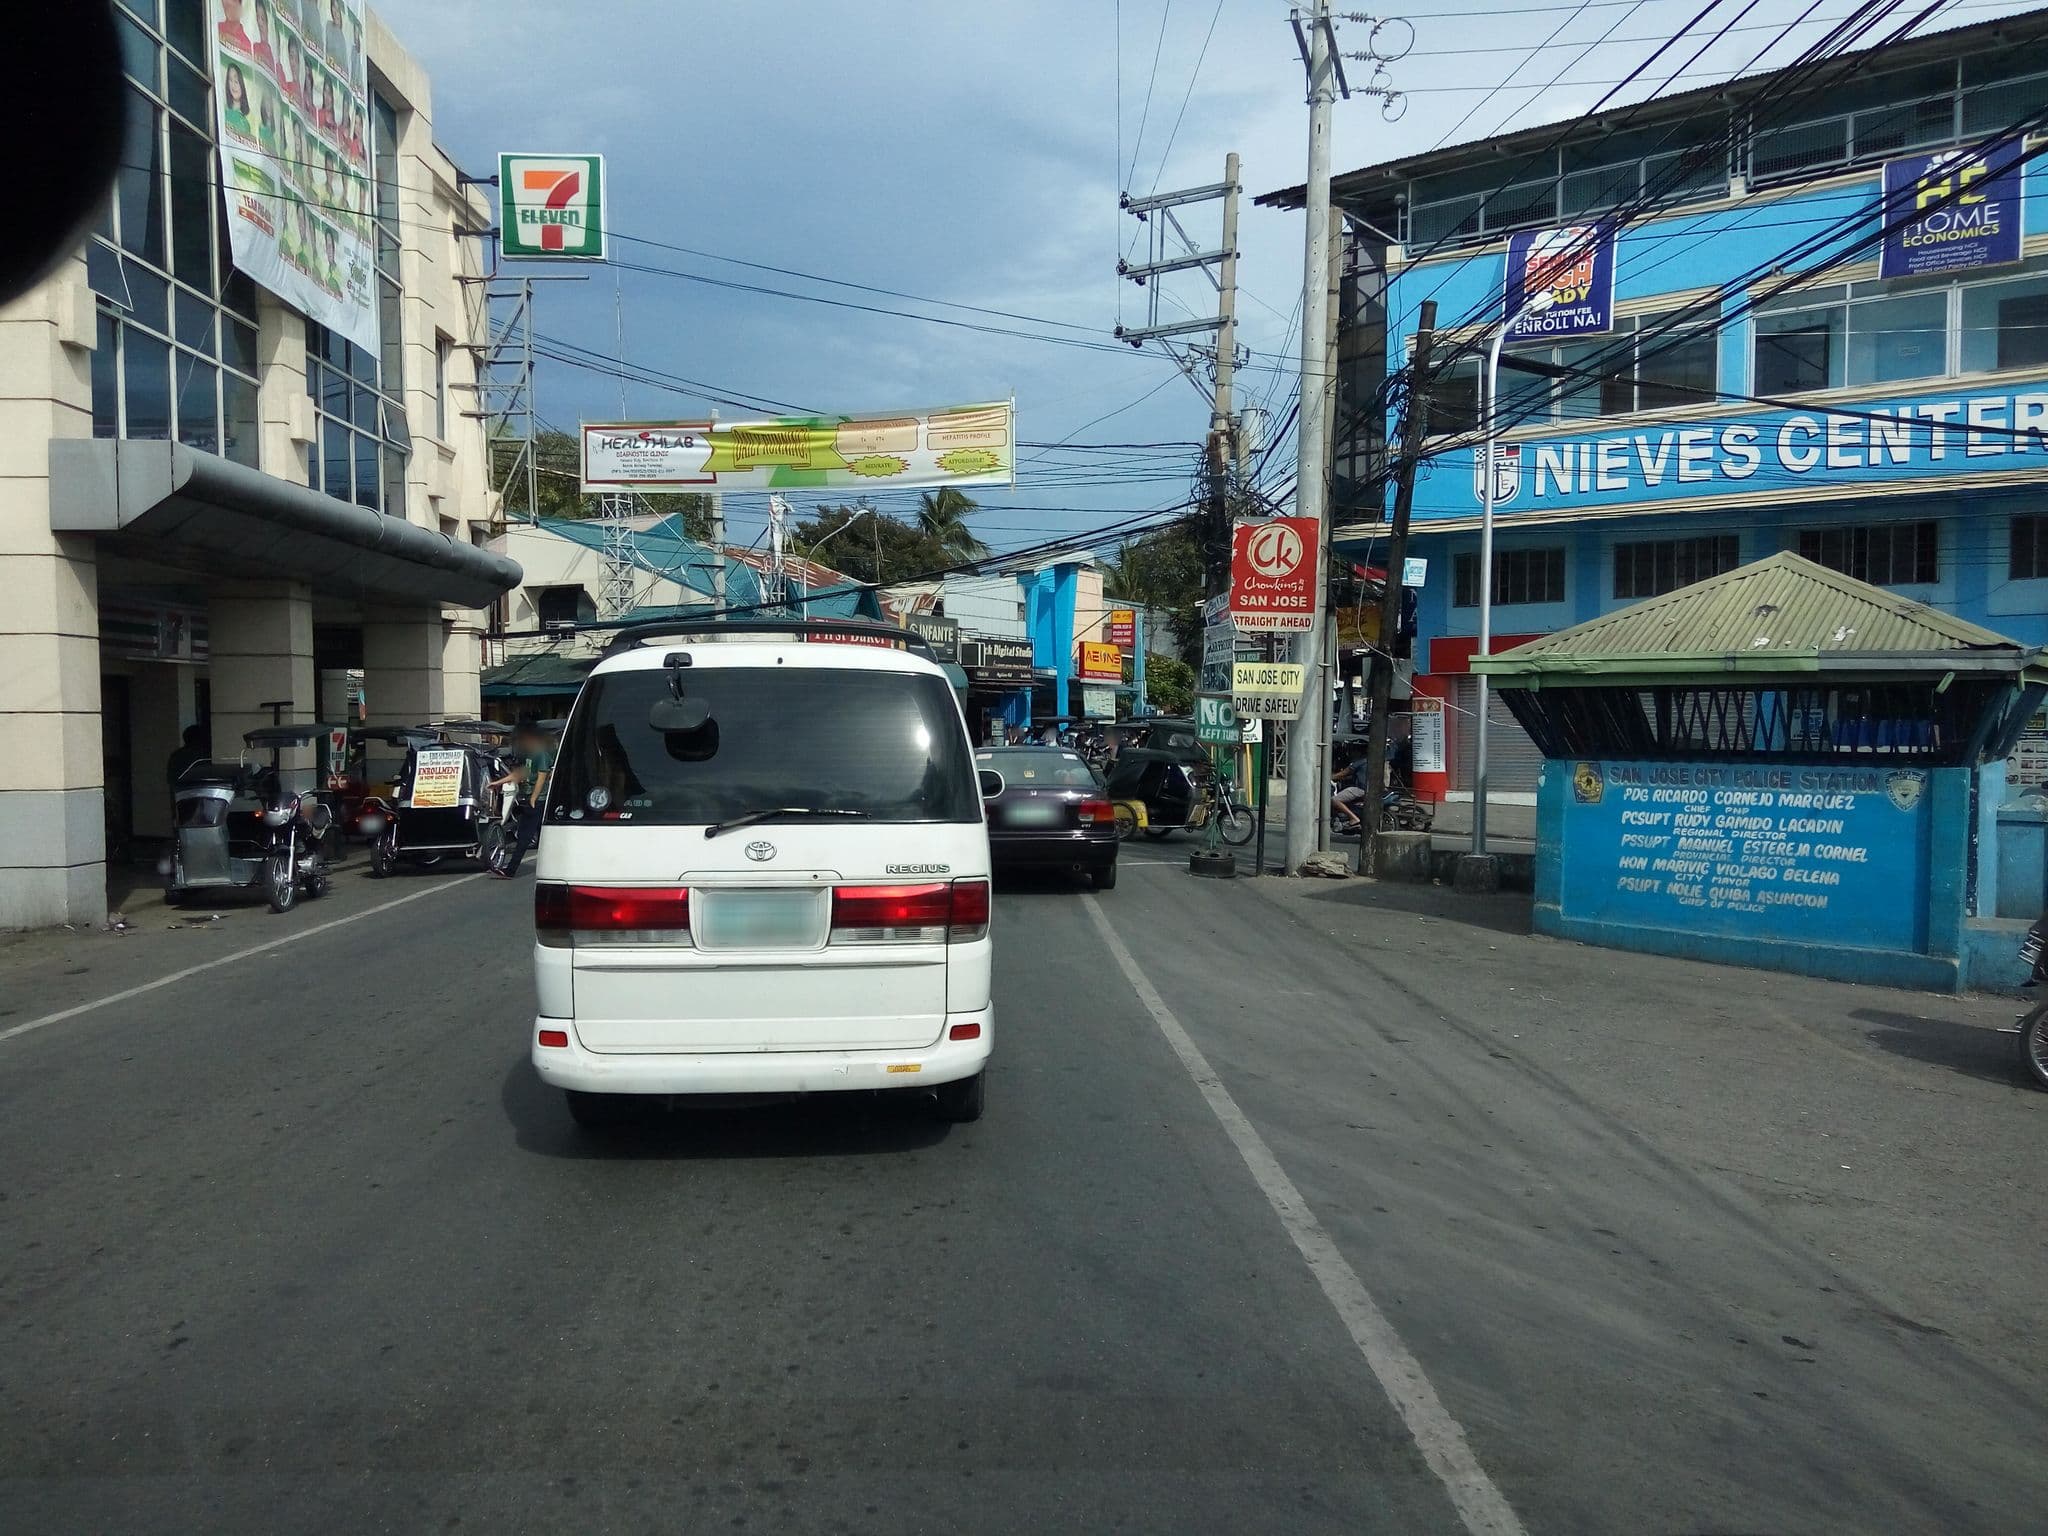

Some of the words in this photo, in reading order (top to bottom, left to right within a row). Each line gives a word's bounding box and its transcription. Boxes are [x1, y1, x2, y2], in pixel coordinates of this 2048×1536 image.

[524, 171, 579, 249] 7
[1903, 224, 2000, 248] ECONOMICS
[1577, 307, 1592, 315] FEE
[1515, 317, 1569, 334] ENROLL
[1574, 313, 1600, 327] NA!
[601, 434, 694, 449] HEALTHLAB
[970, 432, 991, 440] PROFILE
[1534, 425, 1761, 497] NIEVES
[1776, 394, 2048, 473] CENTER
[1244, 577, 1297, 592] Chowking
[1240, 595, 1267, 606] SAN
[1272, 596, 1307, 607] JOSE
[1234, 616, 1278, 627] STRAIGHT
[1281, 617, 1311, 628] AHEAD
[919, 624, 954, 642] INFANTE
[994, 644, 1015, 658] Digital
[1237, 669, 1255, 684] SAN
[1256, 670, 1277, 685] JOSE
[1281, 670, 1300, 686] CITY
[1201, 698, 1236, 727] NO
[1236, 697, 1261, 713] DRIVE
[1265, 698, 1299, 714] SAFELY
[1200, 727, 1220, 741] LEFT
[418, 766, 460, 775] ENROLLMENT
[1609, 766, 1641, 785] SAN
[1648, 767, 1689, 786] JOSE
[1694, 768, 1728, 787] CITY
[1733, 769, 1792, 790] POLICE
[1800, 772, 1880, 793] STATION
[1624, 788, 1649, 802] PDG
[1653, 789, 1708, 804] RICARDO
[1714, 791, 1773, 807] CORNEJO
[1778, 793, 1855, 810] MARQUEZ
[1684, 804, 1712, 813] CHIEF
[1725, 807, 1750, 815] PNP
[1622, 811, 1671, 825] PCSUPT
[1675, 813, 1711, 828] RUDY
[1715, 815, 1772, 831] GAMIDO
[1779, 818, 1843, 834] LACADIN
[1673, 827, 1725, 838] REGIONAL
[1731, 830, 1787, 840] DIRECTOR
[1621, 834, 1671, 848] PSSUPT
[1678, 837, 1734, 853] MANUEL
[1814, 843, 1868, 863] CORNEL
[1673, 850, 1731, 862] PROVINCIAL
[1741, 855, 1796, 867] DIRECTOR
[885, 863, 951, 874] REGIUS
[1619, 855, 1648, 870] HON
[1652, 858, 1710, 875] MARIVIC
[1716, 863, 1777, 880] VIOLAGO
[1783, 868, 1840, 885] BELENA
[1675, 873, 1704, 882] CITY
[1712, 876, 1750, 887] MAYOR
[1617, 876, 1662, 893] PSUPT
[1757, 890, 1828, 908] ASUNCION
[1679, 896, 1707, 907] CHIEF
[1710, 898, 1724, 908] OF
[1727, 902, 1766, 913] POLICE
